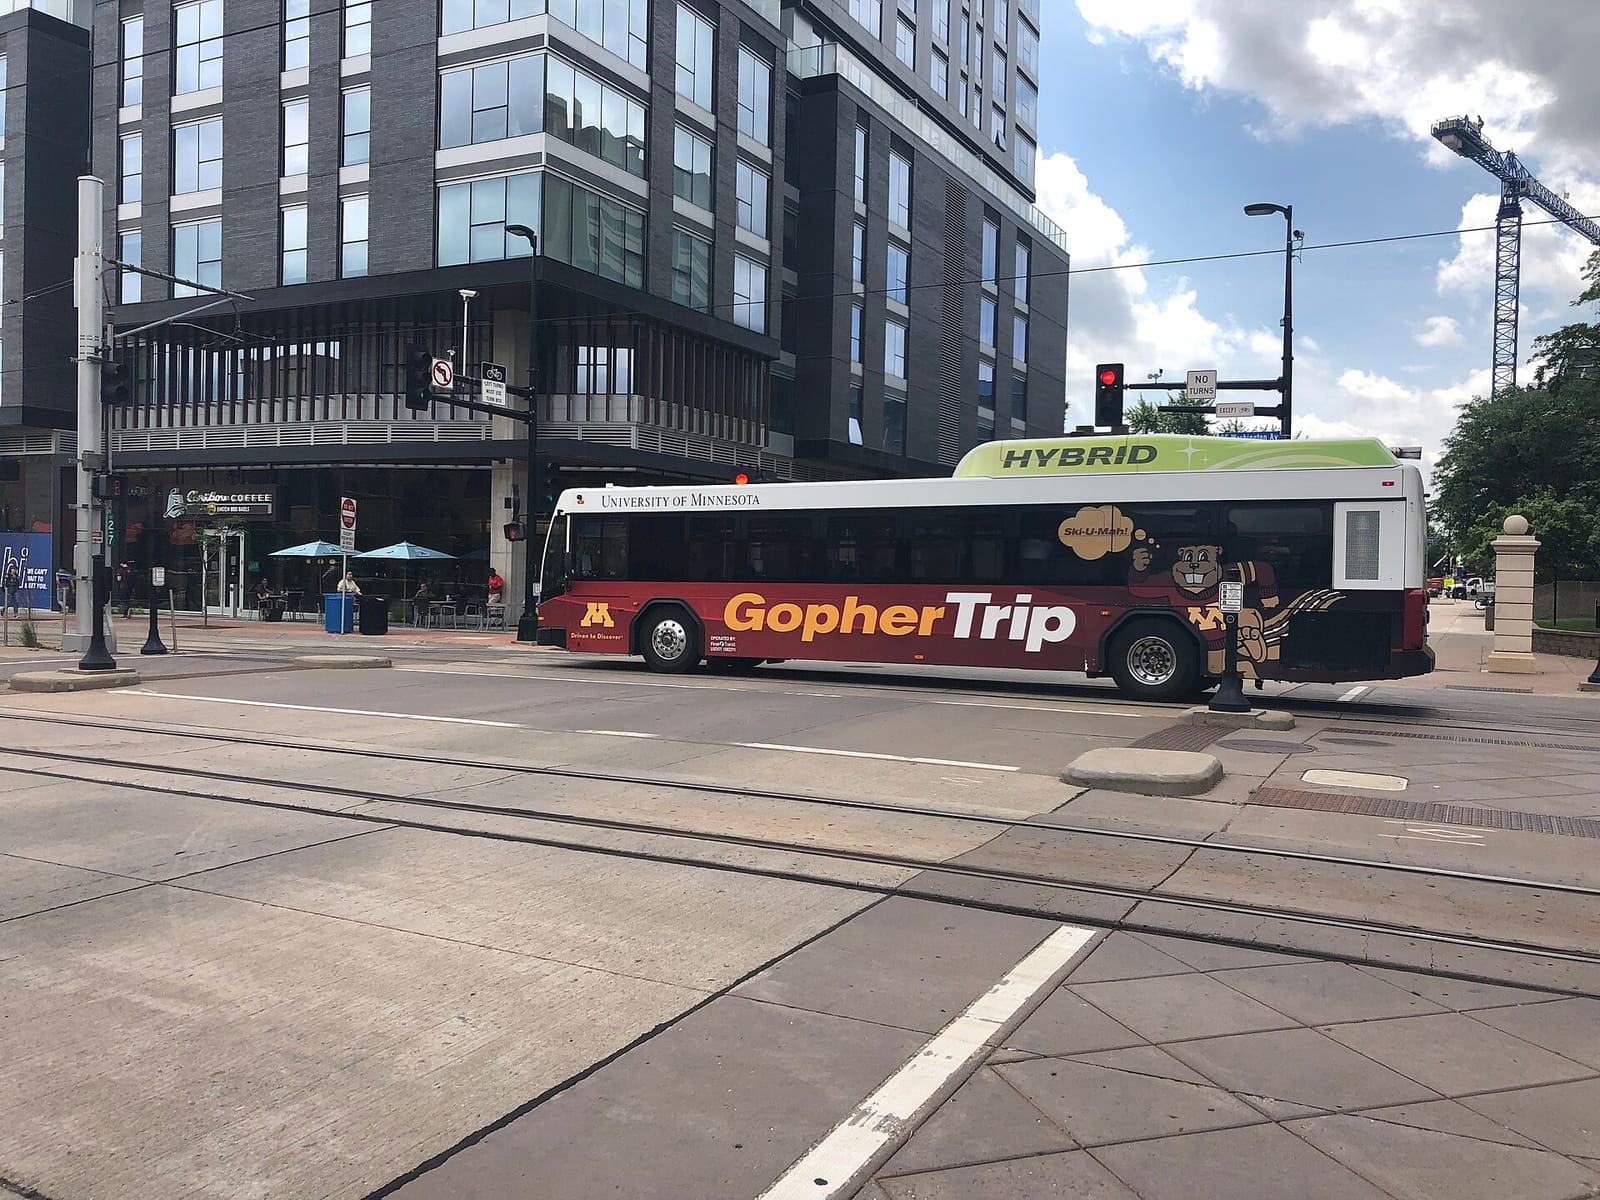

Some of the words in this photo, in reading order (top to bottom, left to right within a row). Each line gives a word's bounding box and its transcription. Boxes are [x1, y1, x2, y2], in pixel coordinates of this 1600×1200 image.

[1195, 375, 1209, 383] NO
[1190, 387, 1214, 395] TURNS
[1003, 445, 1158, 468] HYBRID
[186, 490, 228, 502] Caribou
[230, 494, 272, 502] COFFEE
[601, 495, 669, 508] UNIVERSITY
[672, 496, 687, 507] OF
[691, 493, 760, 507] MINNESOTA
[580, 602, 615, 627] M
